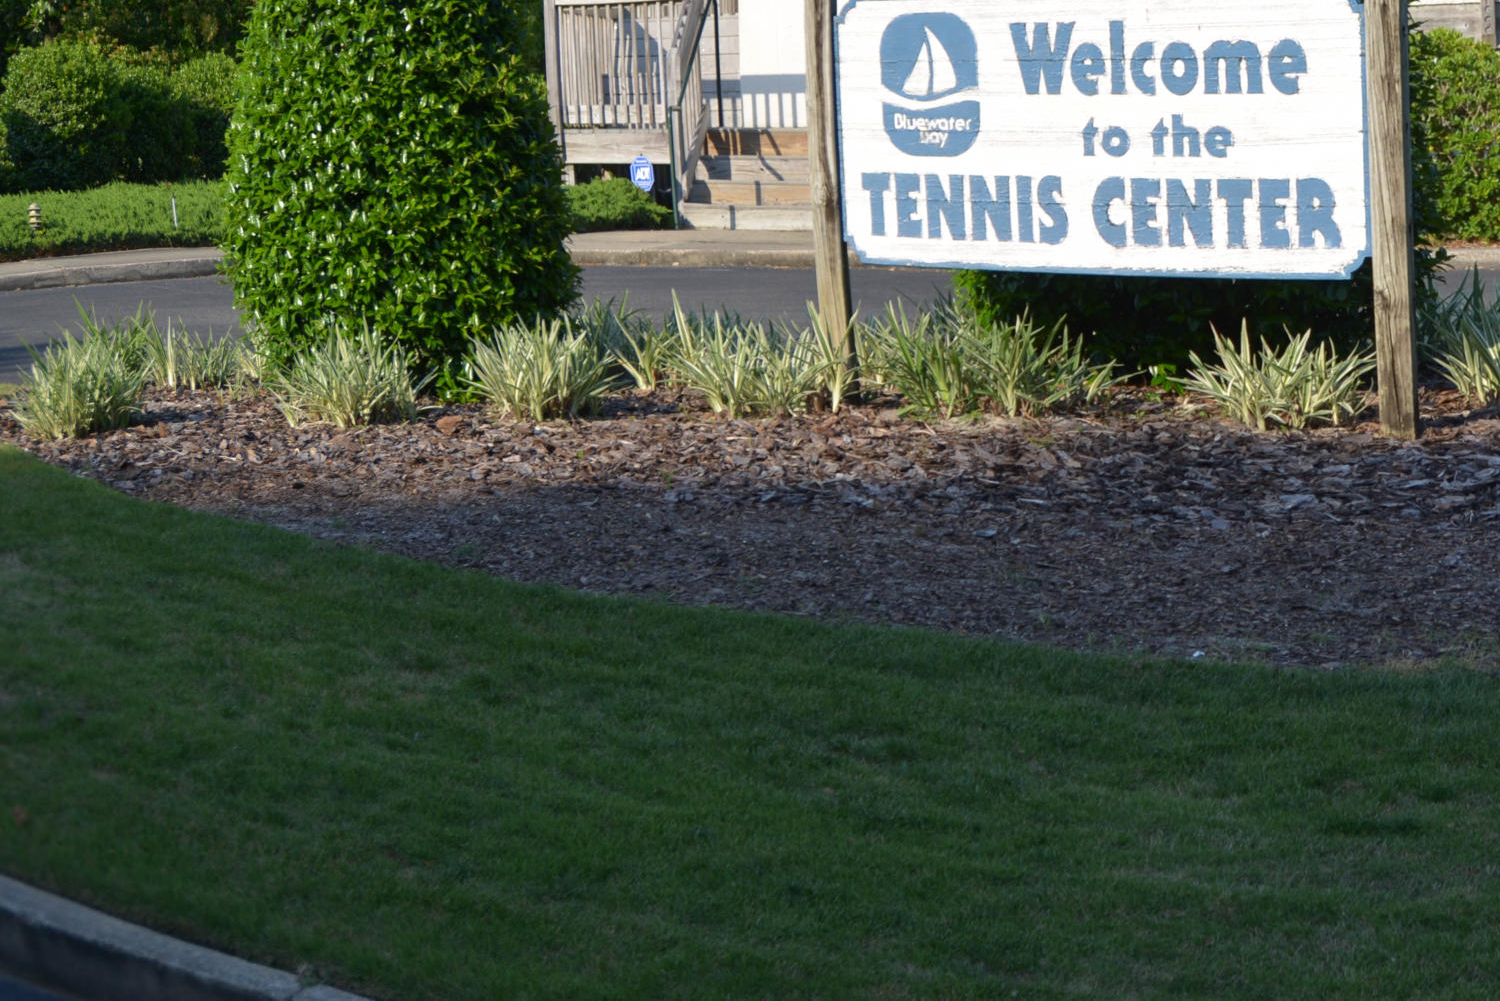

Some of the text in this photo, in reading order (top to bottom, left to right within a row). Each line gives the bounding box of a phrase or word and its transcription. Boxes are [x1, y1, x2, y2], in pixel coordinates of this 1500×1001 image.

[1009, 20, 1308, 96] Welcome
[893, 113, 972, 131] Bluewater
[1082, 114, 1235, 158] to the
[862, 172, 1342, 249] TENNIS CENTER
